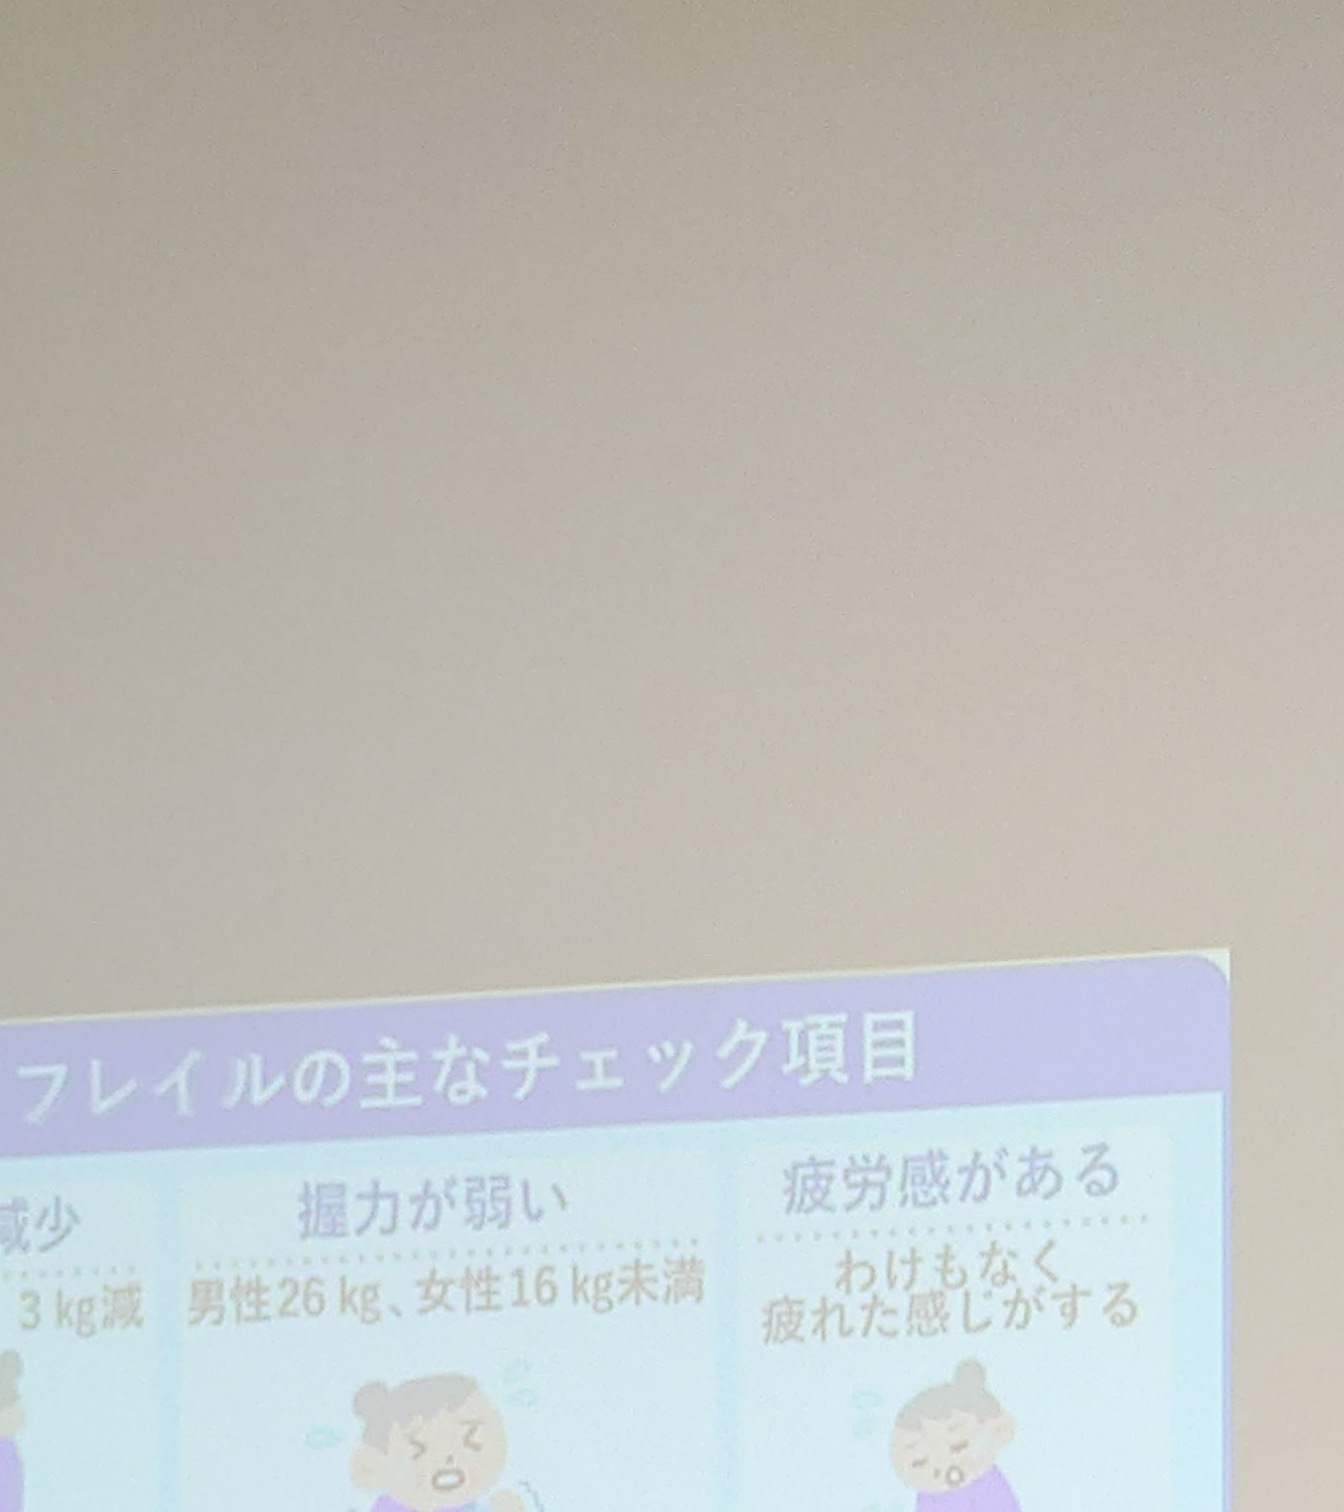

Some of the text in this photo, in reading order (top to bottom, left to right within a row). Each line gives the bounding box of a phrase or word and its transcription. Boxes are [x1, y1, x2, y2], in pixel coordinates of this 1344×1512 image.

[17, 1009, 916, 1125] フレイルの主なチェック項目
[299, 1176, 569, 1239] 握力が弱い
[783, 1141, 1120, 1215] 疲労感がある
[835, 1240, 1060, 1294] わけもなく
[762, 1282, 1139, 1346] 疲れた感じがする
